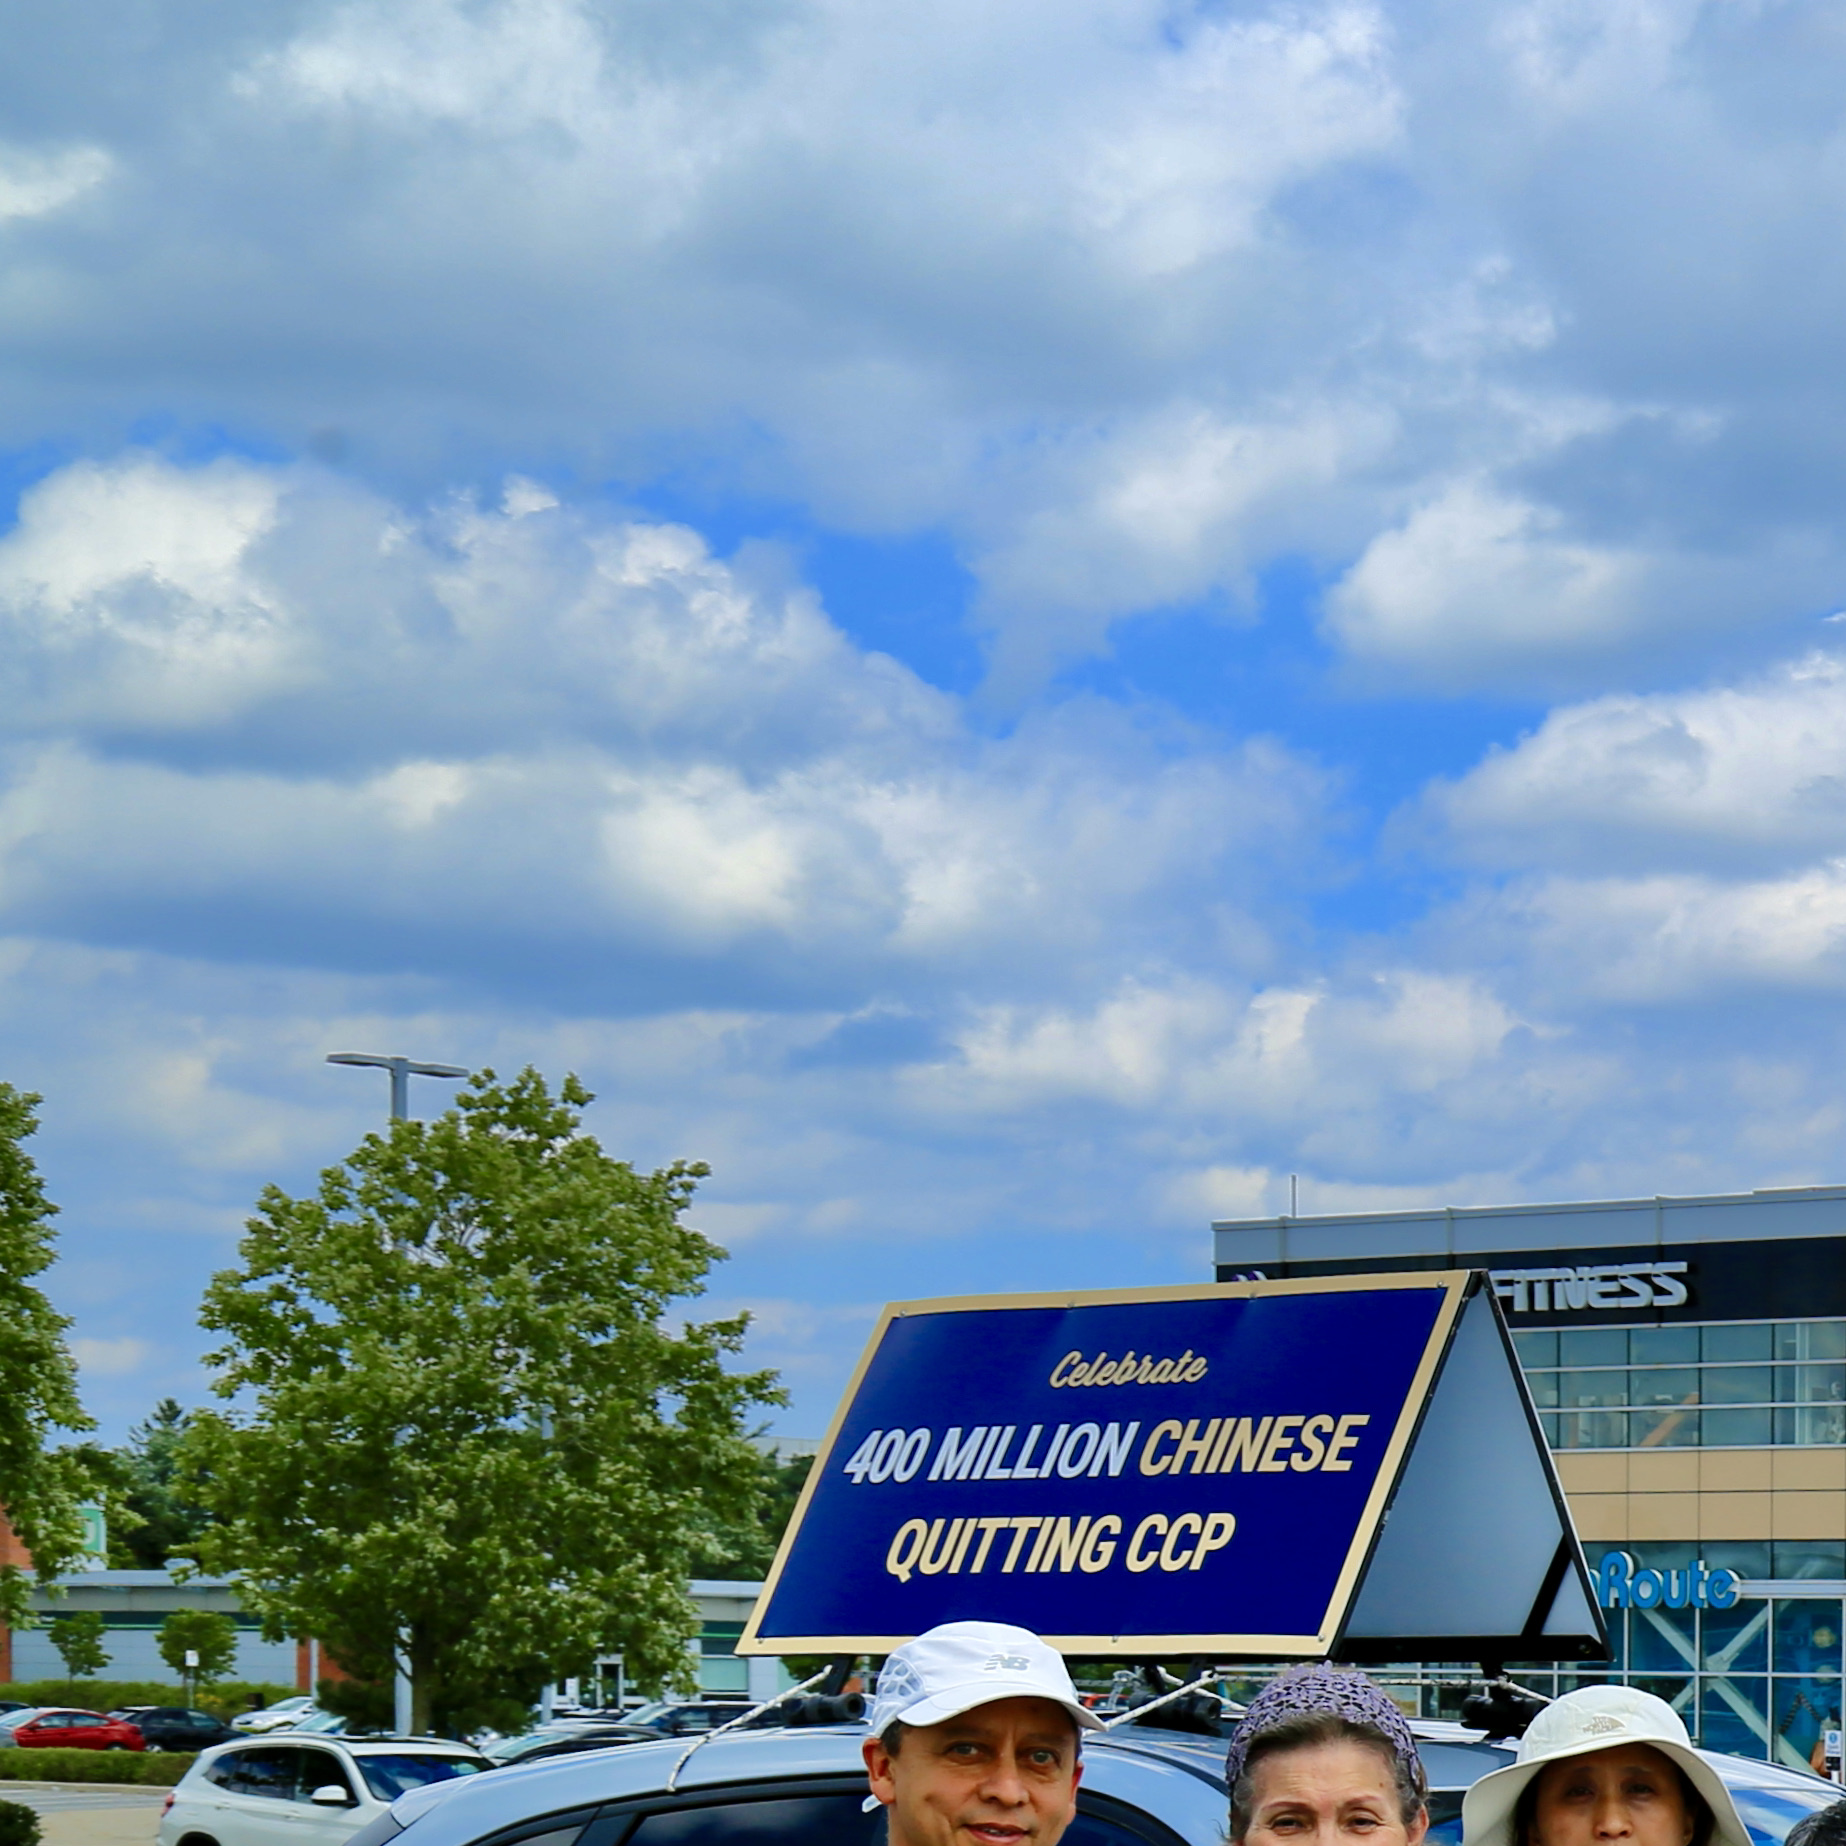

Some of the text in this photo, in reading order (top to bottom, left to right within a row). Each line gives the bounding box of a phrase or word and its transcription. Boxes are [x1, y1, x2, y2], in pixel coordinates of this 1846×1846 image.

[1489, 1261, 1688, 1311] FITNESS
[1050, 1350, 1208, 1388] Celebrate
[843, 1414, 1370, 1484] 400 MILLION CHINESE
[886, 1512, 1236, 1583] QUITTING CCP
